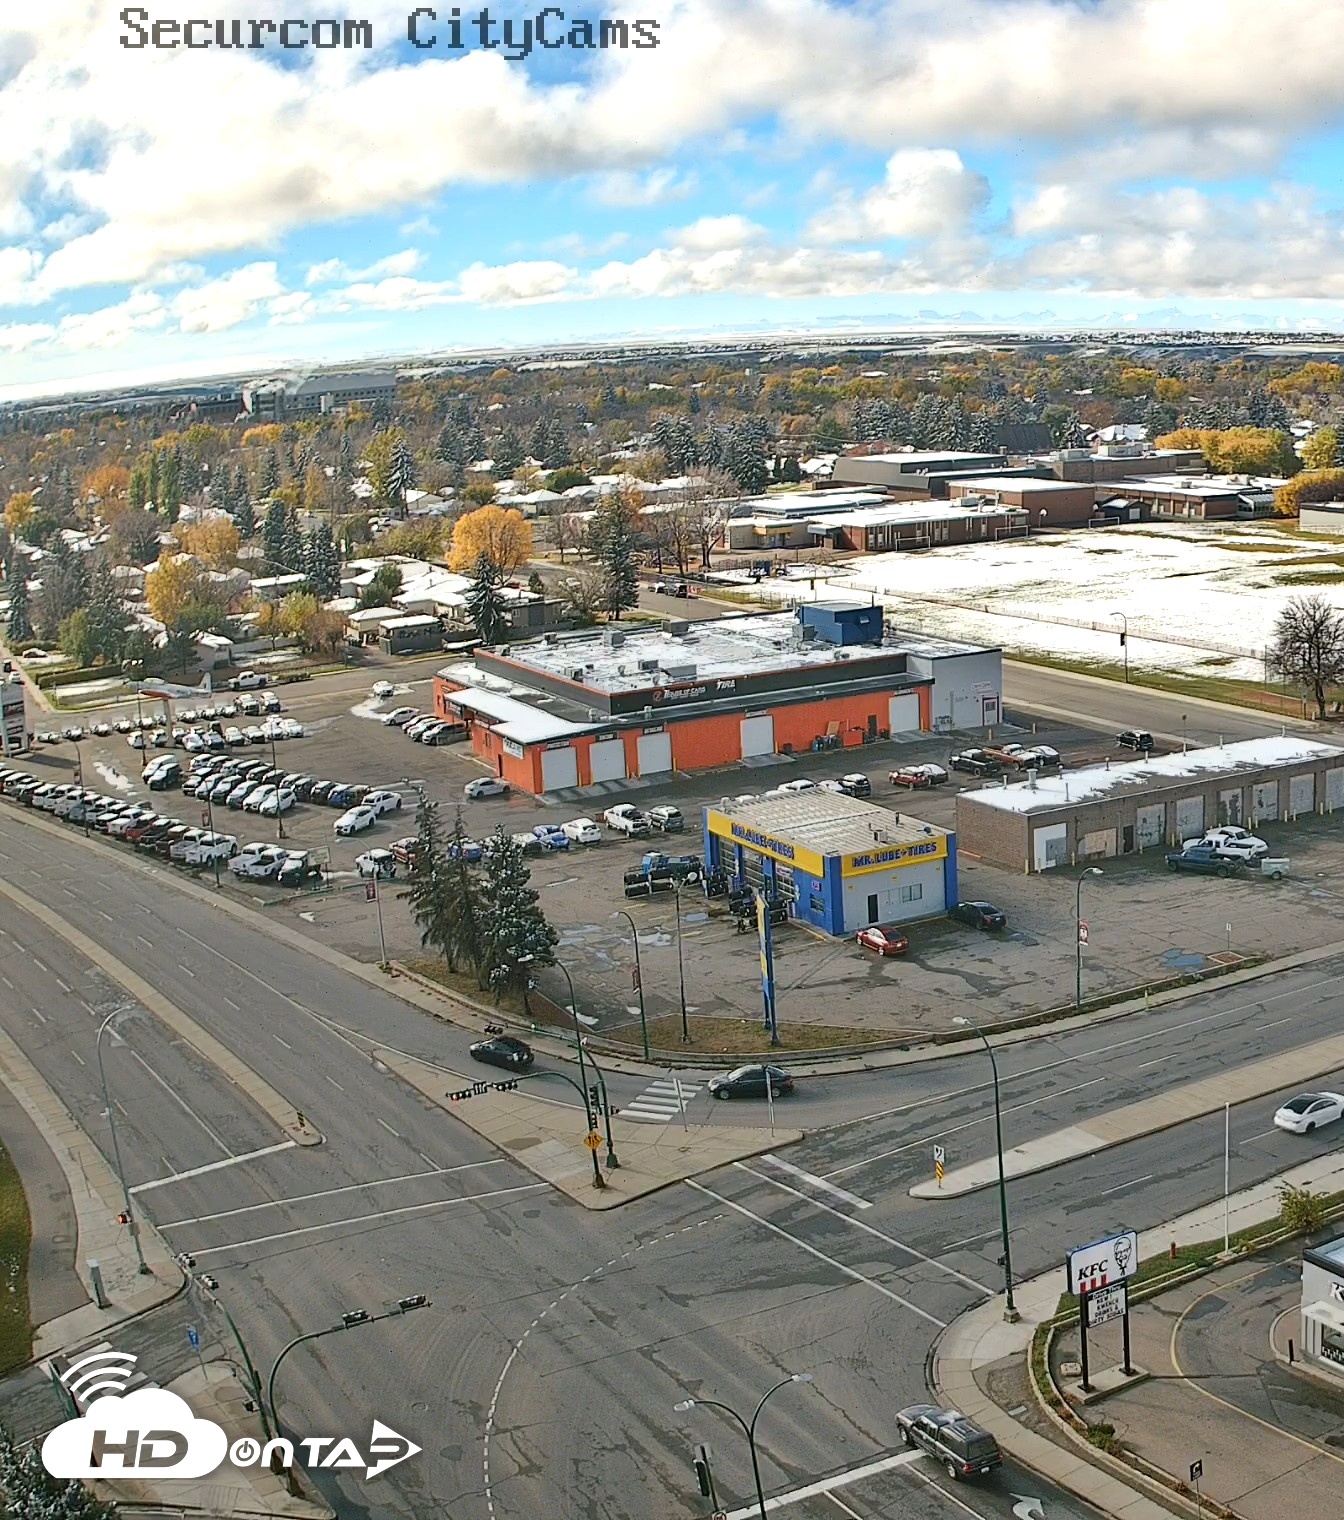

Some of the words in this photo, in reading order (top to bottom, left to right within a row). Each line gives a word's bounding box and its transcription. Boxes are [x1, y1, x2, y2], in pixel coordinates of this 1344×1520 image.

[875, 849, 901, 864] LUBE
[907, 841, 937, 857] TIRES
[1077, 1259, 1109, 1280] KFC
